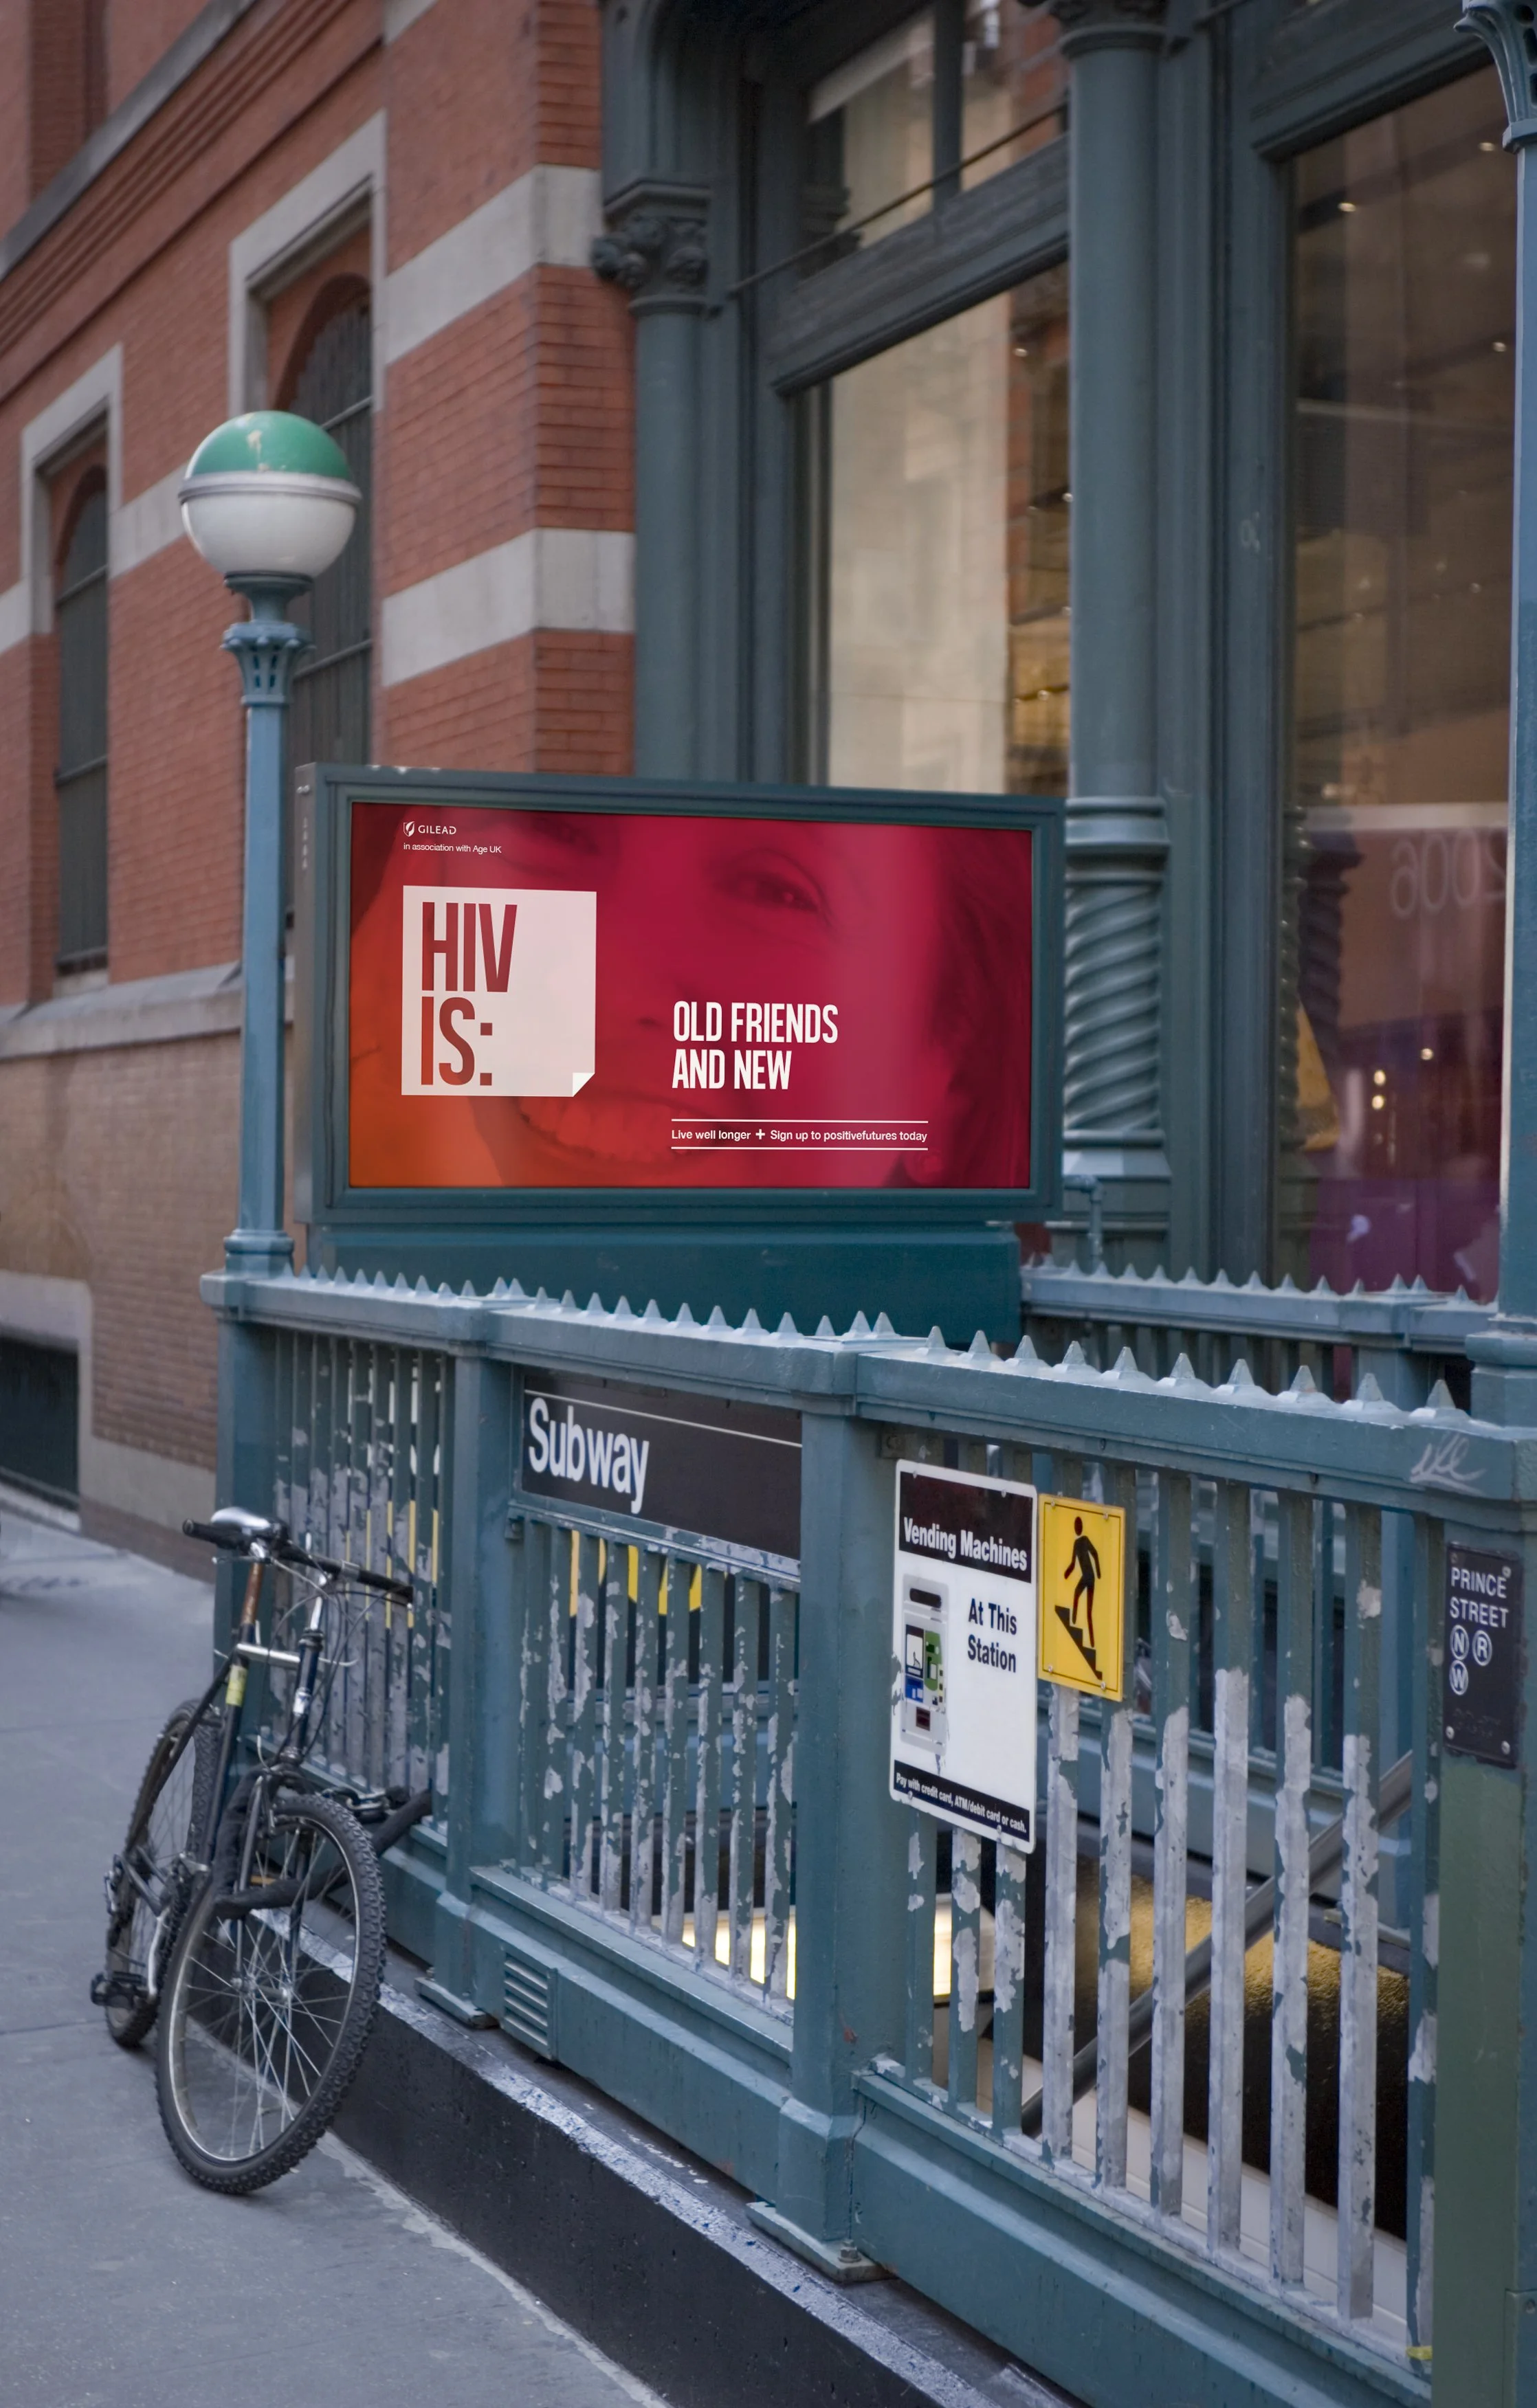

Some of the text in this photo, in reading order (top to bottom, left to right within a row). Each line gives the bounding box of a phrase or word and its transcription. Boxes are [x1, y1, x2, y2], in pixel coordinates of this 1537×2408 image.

[412, 843, 454, 851] association
[473, 845, 488, 855] Age
[489, 845, 502, 854] UK
[417, 825, 457, 835] GILEAD
[421, 901, 518, 992] HIV
[421, 996, 493, 1086] IS:
[673, 1001, 839, 1043] OLD FRIENDS
[672, 1049, 792, 1090] AND NEW
[672, 1129, 693, 1139] Live
[695, 1130, 716, 1139] well
[718, 1130, 751, 1141] longer
[770, 1130, 793, 1142] Sign
[795, 1132, 808, 1142] up
[811, 1130, 821, 1140] to
[823, 1130, 897, 1142] positivefutures
[899, 1130, 927, 1143] today
[529, 1397, 650, 1515] Subway
[903, 1516, 1028, 1572] Vending Machines
[1450, 1566, 1507, 1599] PRINCE
[968, 1598, 1017, 1636] At This
[1450, 1596, 1509, 1629] STREET
[967, 1634, 1017, 1673] Station
[896, 1772, 1027, 1833] Pay with credit card, ATM/debit card or cash.
